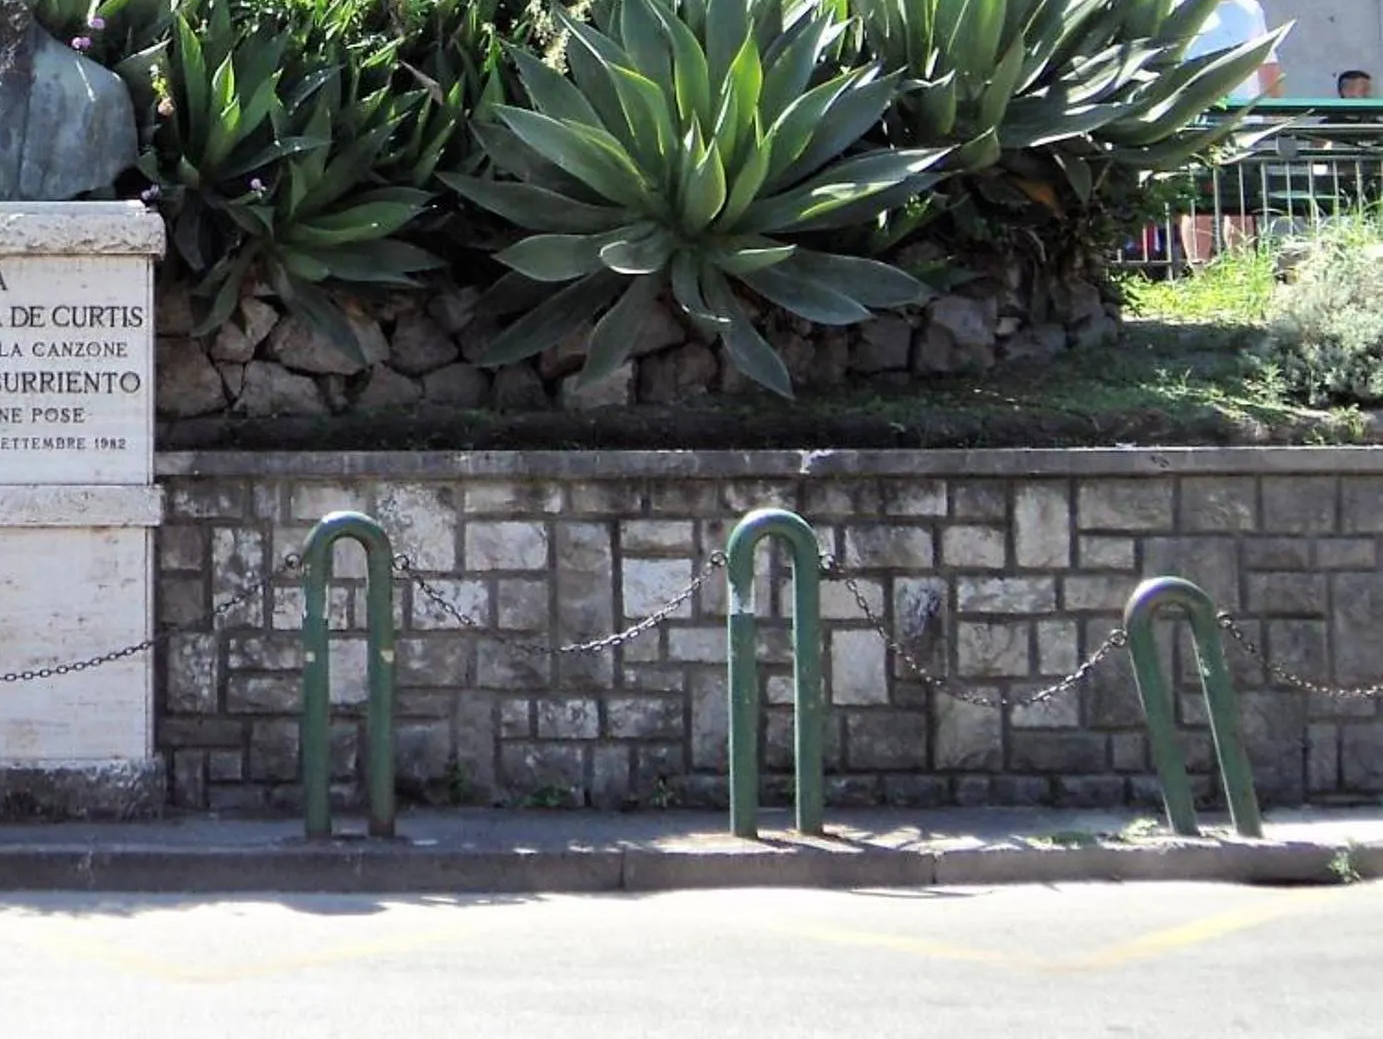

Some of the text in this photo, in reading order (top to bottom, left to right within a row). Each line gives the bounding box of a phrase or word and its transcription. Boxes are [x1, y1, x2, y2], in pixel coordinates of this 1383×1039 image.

[10, 305, 46, 328] DE
[51, 305, 144, 328] CURTIS
[31, 341, 129, 358] CANZONE
[31, 407, 86, 424] POSE
